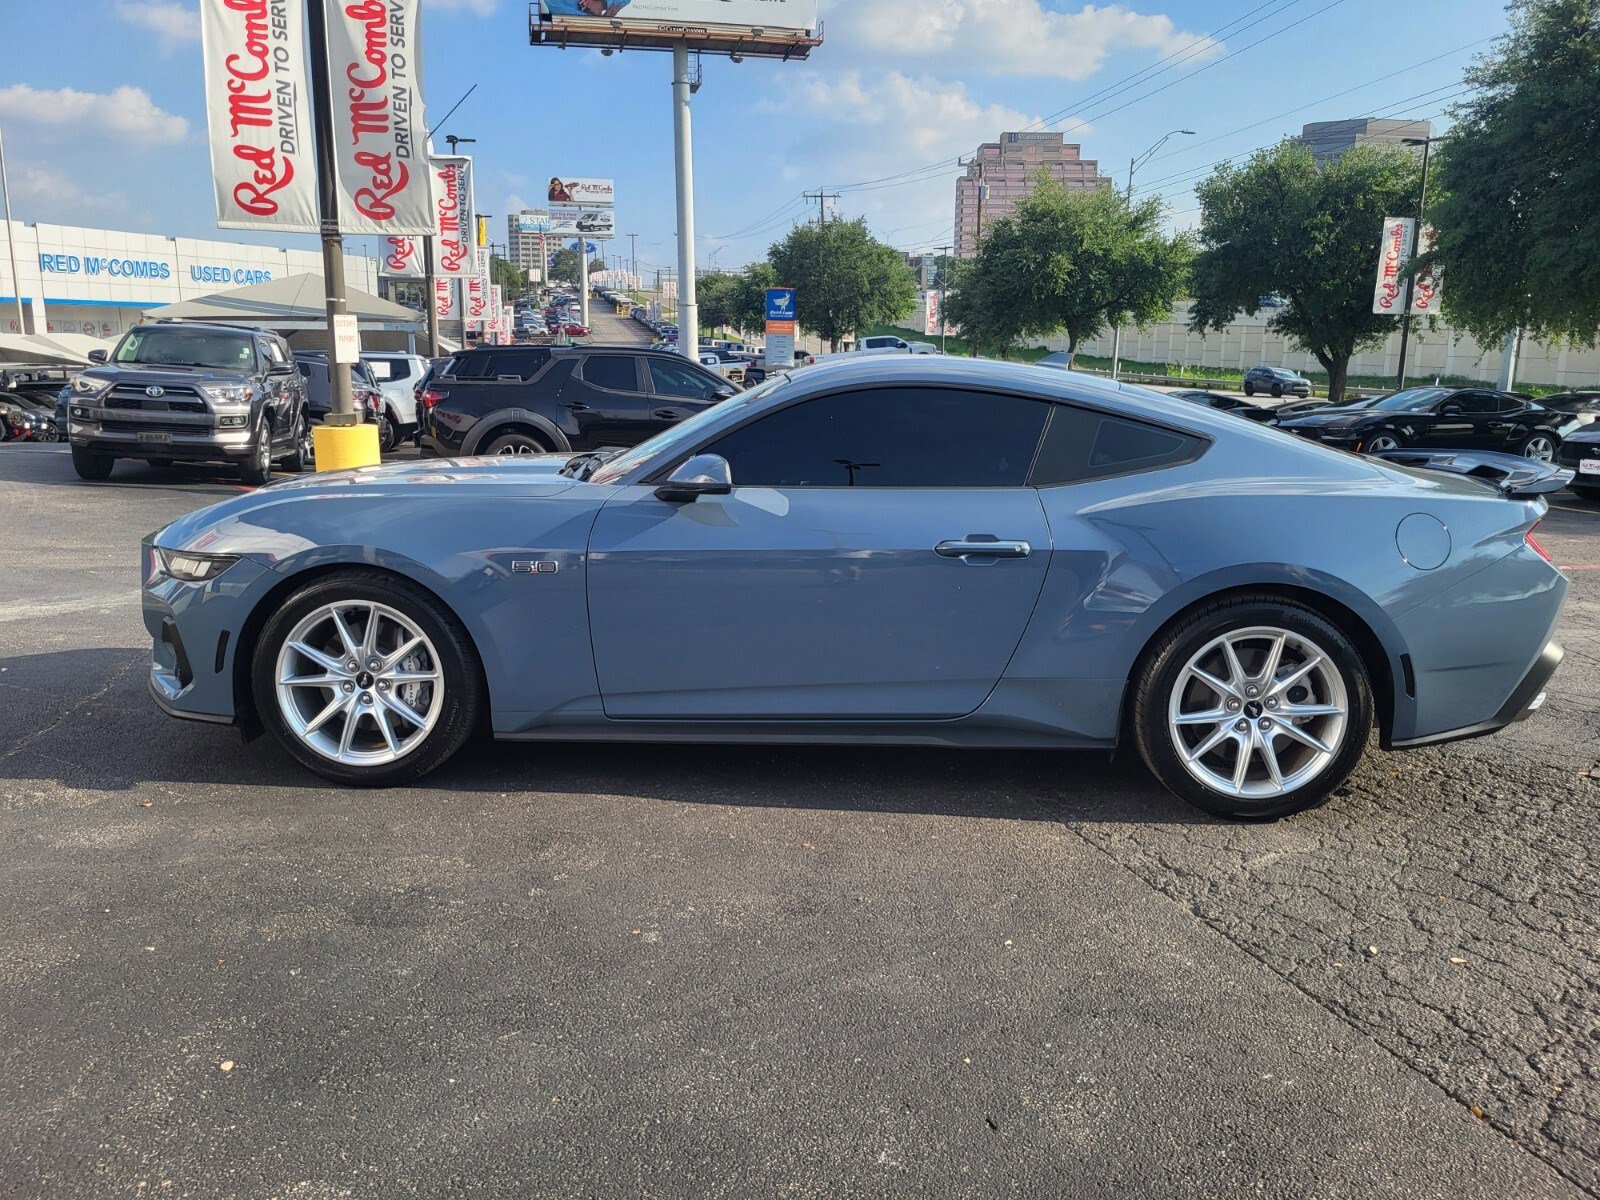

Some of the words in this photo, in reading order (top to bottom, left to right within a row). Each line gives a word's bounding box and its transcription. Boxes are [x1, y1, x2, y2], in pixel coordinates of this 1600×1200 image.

[274, 47, 290, 74] TO
[391, 53, 406, 79] TO
[274, 82, 296, 155] DRIVEN
[392, 86, 411, 159] DRIVEN
[233, 144, 294, 216] Red
[354, 151, 409, 221] Red
[457, 163, 466, 191] SERVE
[437, 163, 459, 236] McCombs
[458, 194, 466, 208] TO
[458, 209, 469, 243] DRIVEN
[386, 237, 414, 270] Red
[440, 239, 468, 272] Red
[1383, 223, 1403, 280] McCombs
[1400, 248, 1407, 257] TO
[40, 252, 80, 273] RED
[190, 264, 231, 284] USED
[233, 268, 272, 285] CARS
[481, 268, 487, 278] TO
[436, 296, 454, 316] Red
[470, 296, 486, 317] Red
[1379, 283, 1400, 308] Red
[1415, 283, 1436, 308] Red
